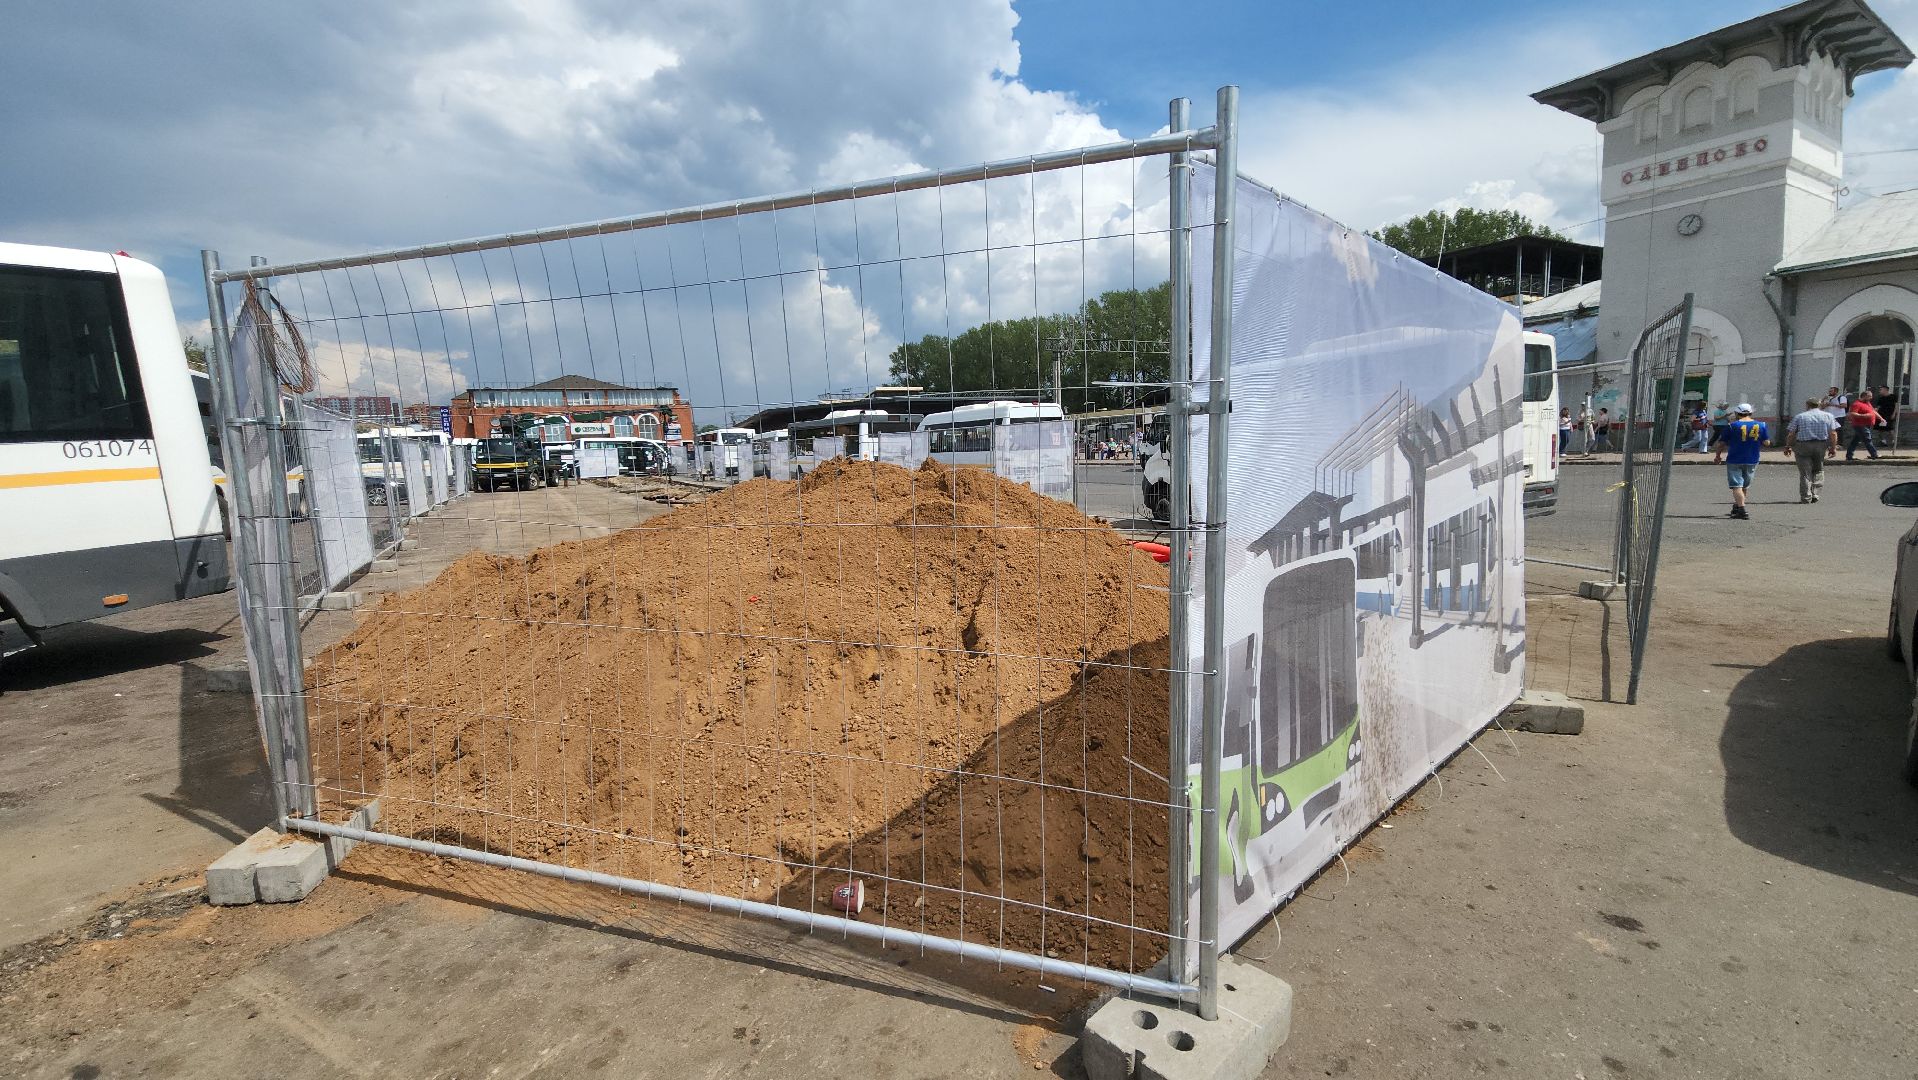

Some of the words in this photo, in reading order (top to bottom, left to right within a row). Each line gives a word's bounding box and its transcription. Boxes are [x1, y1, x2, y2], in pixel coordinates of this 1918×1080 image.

[1622, 138, 1768, 185] ОДИНЦОВО
[1740, 423, 1760, 442] 14
[62, 439, 152, 459] 061074
